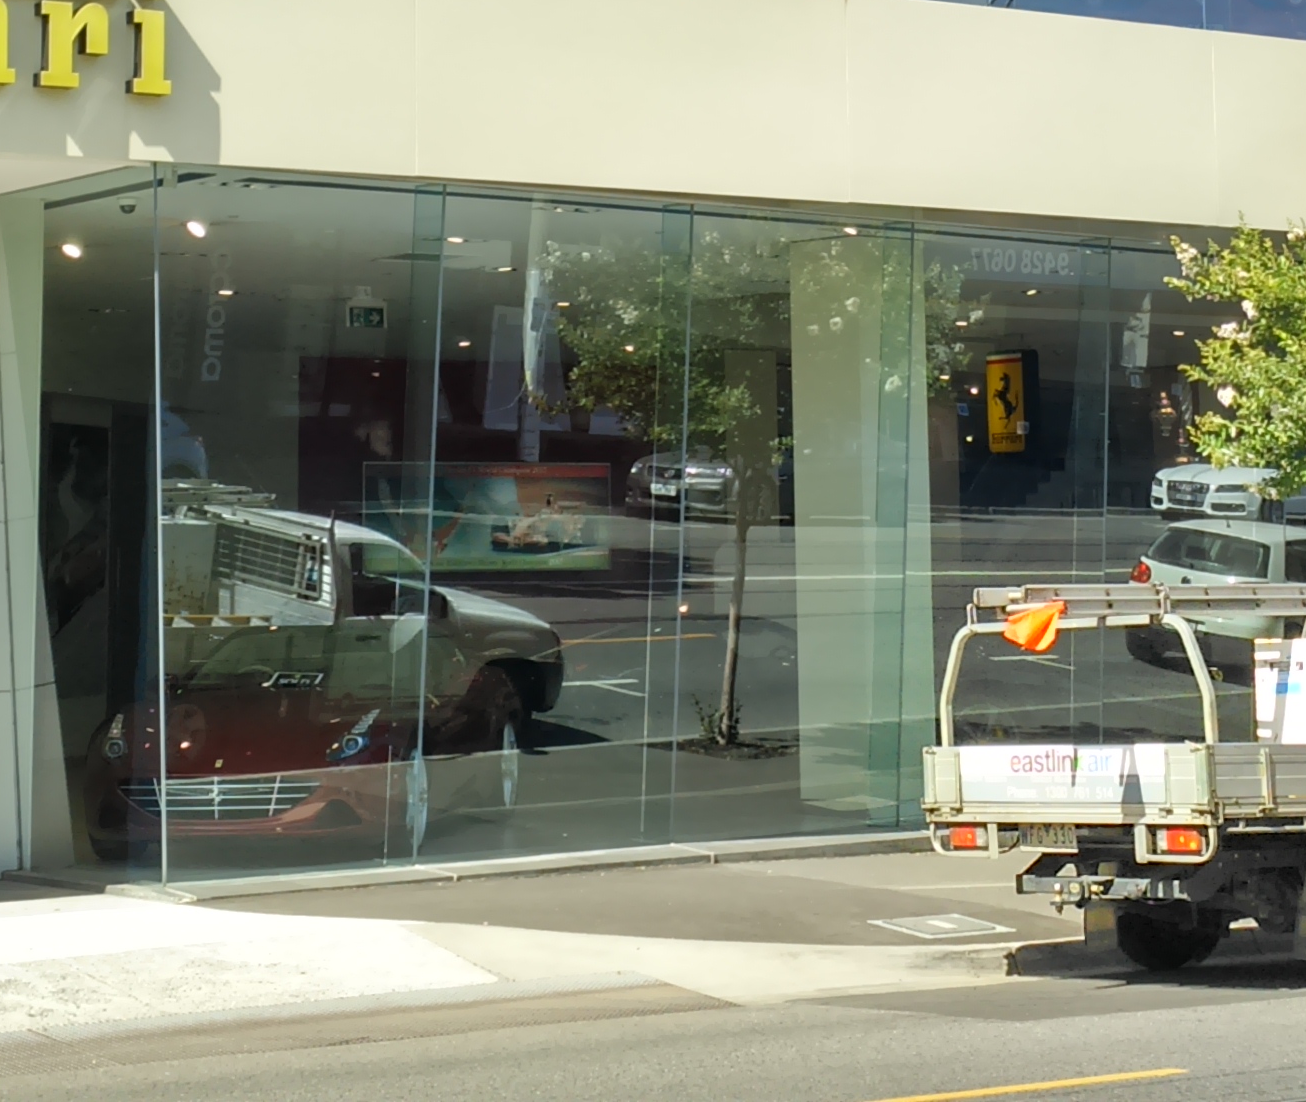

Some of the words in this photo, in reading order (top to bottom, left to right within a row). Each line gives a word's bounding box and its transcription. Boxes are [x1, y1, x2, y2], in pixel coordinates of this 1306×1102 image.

[1010, 748, 1084, 773] eastlink
[1088, 754, 1113, 773] air
[1095, 786, 1114, 798] 514
